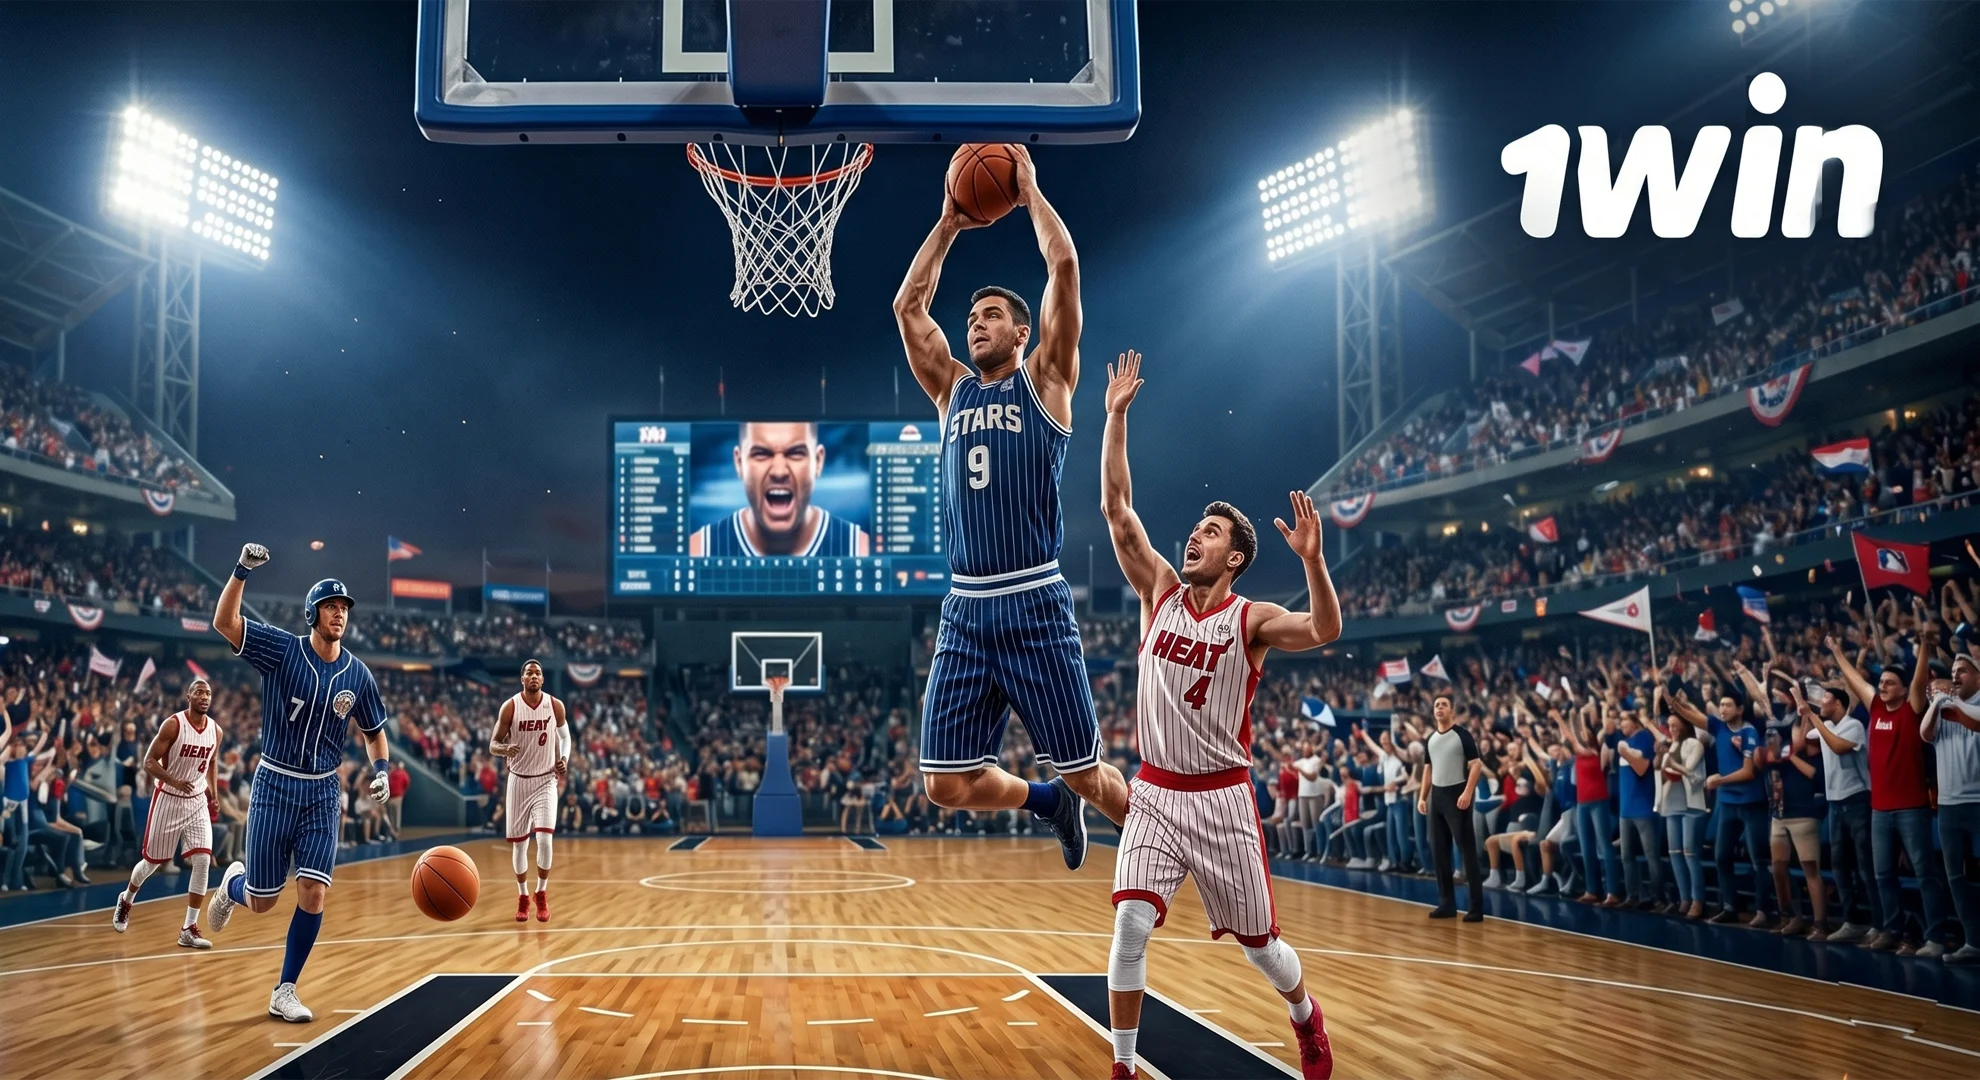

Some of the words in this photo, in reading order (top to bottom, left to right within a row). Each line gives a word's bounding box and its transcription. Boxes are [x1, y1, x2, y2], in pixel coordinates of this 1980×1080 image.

[949, 403, 1022, 444] STARS
[968, 445, 990, 490] 9
[1152, 636, 1234, 672] HEAT
[289, 696, 305, 721] 7
[1184, 675, 1212, 710] 4
[519, 715, 551, 732] HEAT
[180, 743, 215, 759] HEAT
